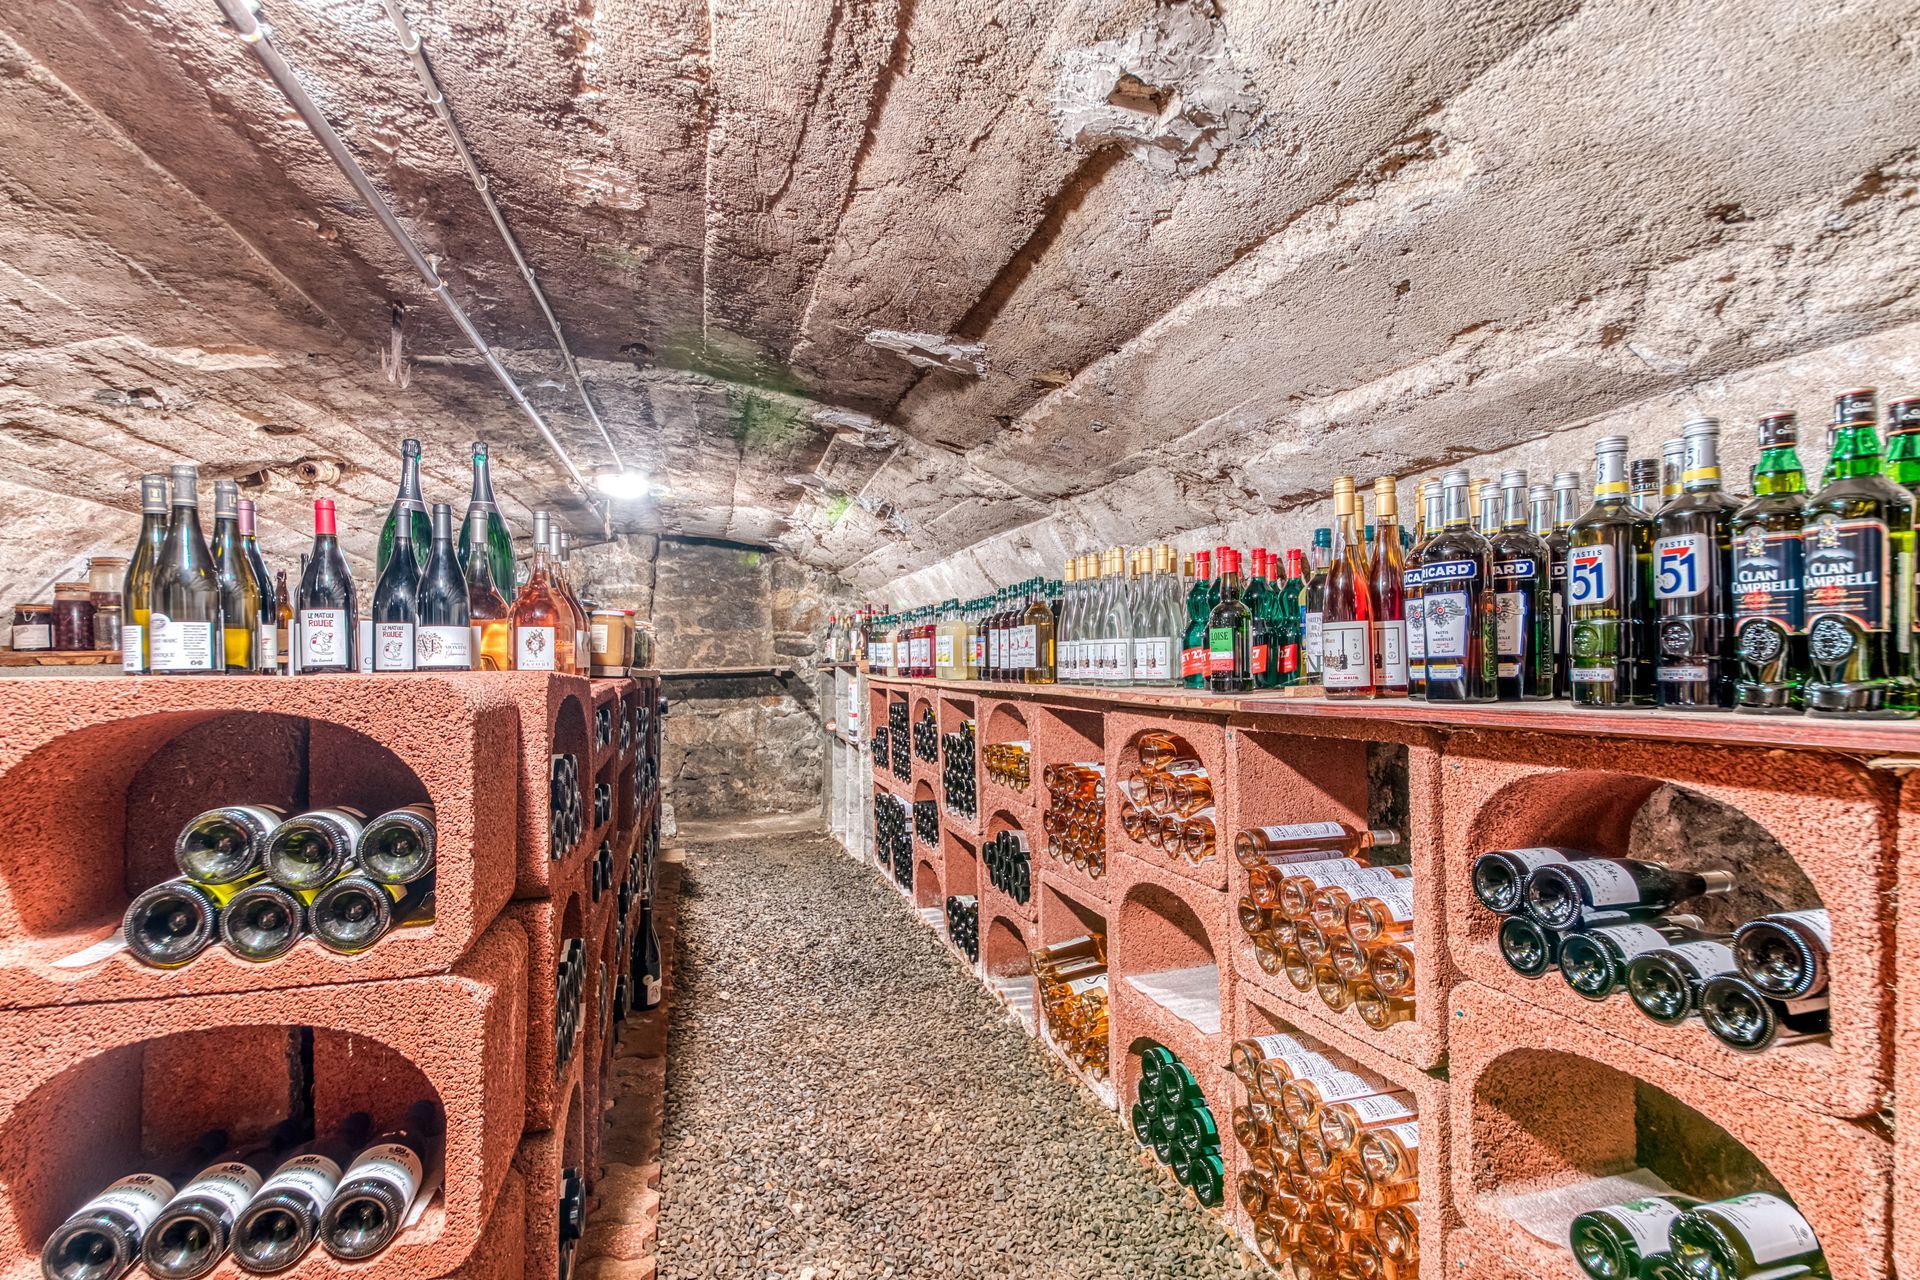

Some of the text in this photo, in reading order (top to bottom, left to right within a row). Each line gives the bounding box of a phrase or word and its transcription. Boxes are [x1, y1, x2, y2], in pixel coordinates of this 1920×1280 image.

[1659, 539, 1695, 550] PASTIS
[1572, 550, 1603, 559] PASTIS
[1423, 564, 1470, 579] RICARD
[1494, 563, 1529, 575] ARD
[1659, 553, 1697, 594] 51
[1739, 569, 1778, 582] CLAN
[1811, 561, 1854, 576] CLAN
[1571, 562, 1604, 600] 51
[1732, 578, 1800, 594] CAMPBELL
[1803, 571, 1878, 588] CAMPBELL
[308, 620, 334, 628] ROUGE
